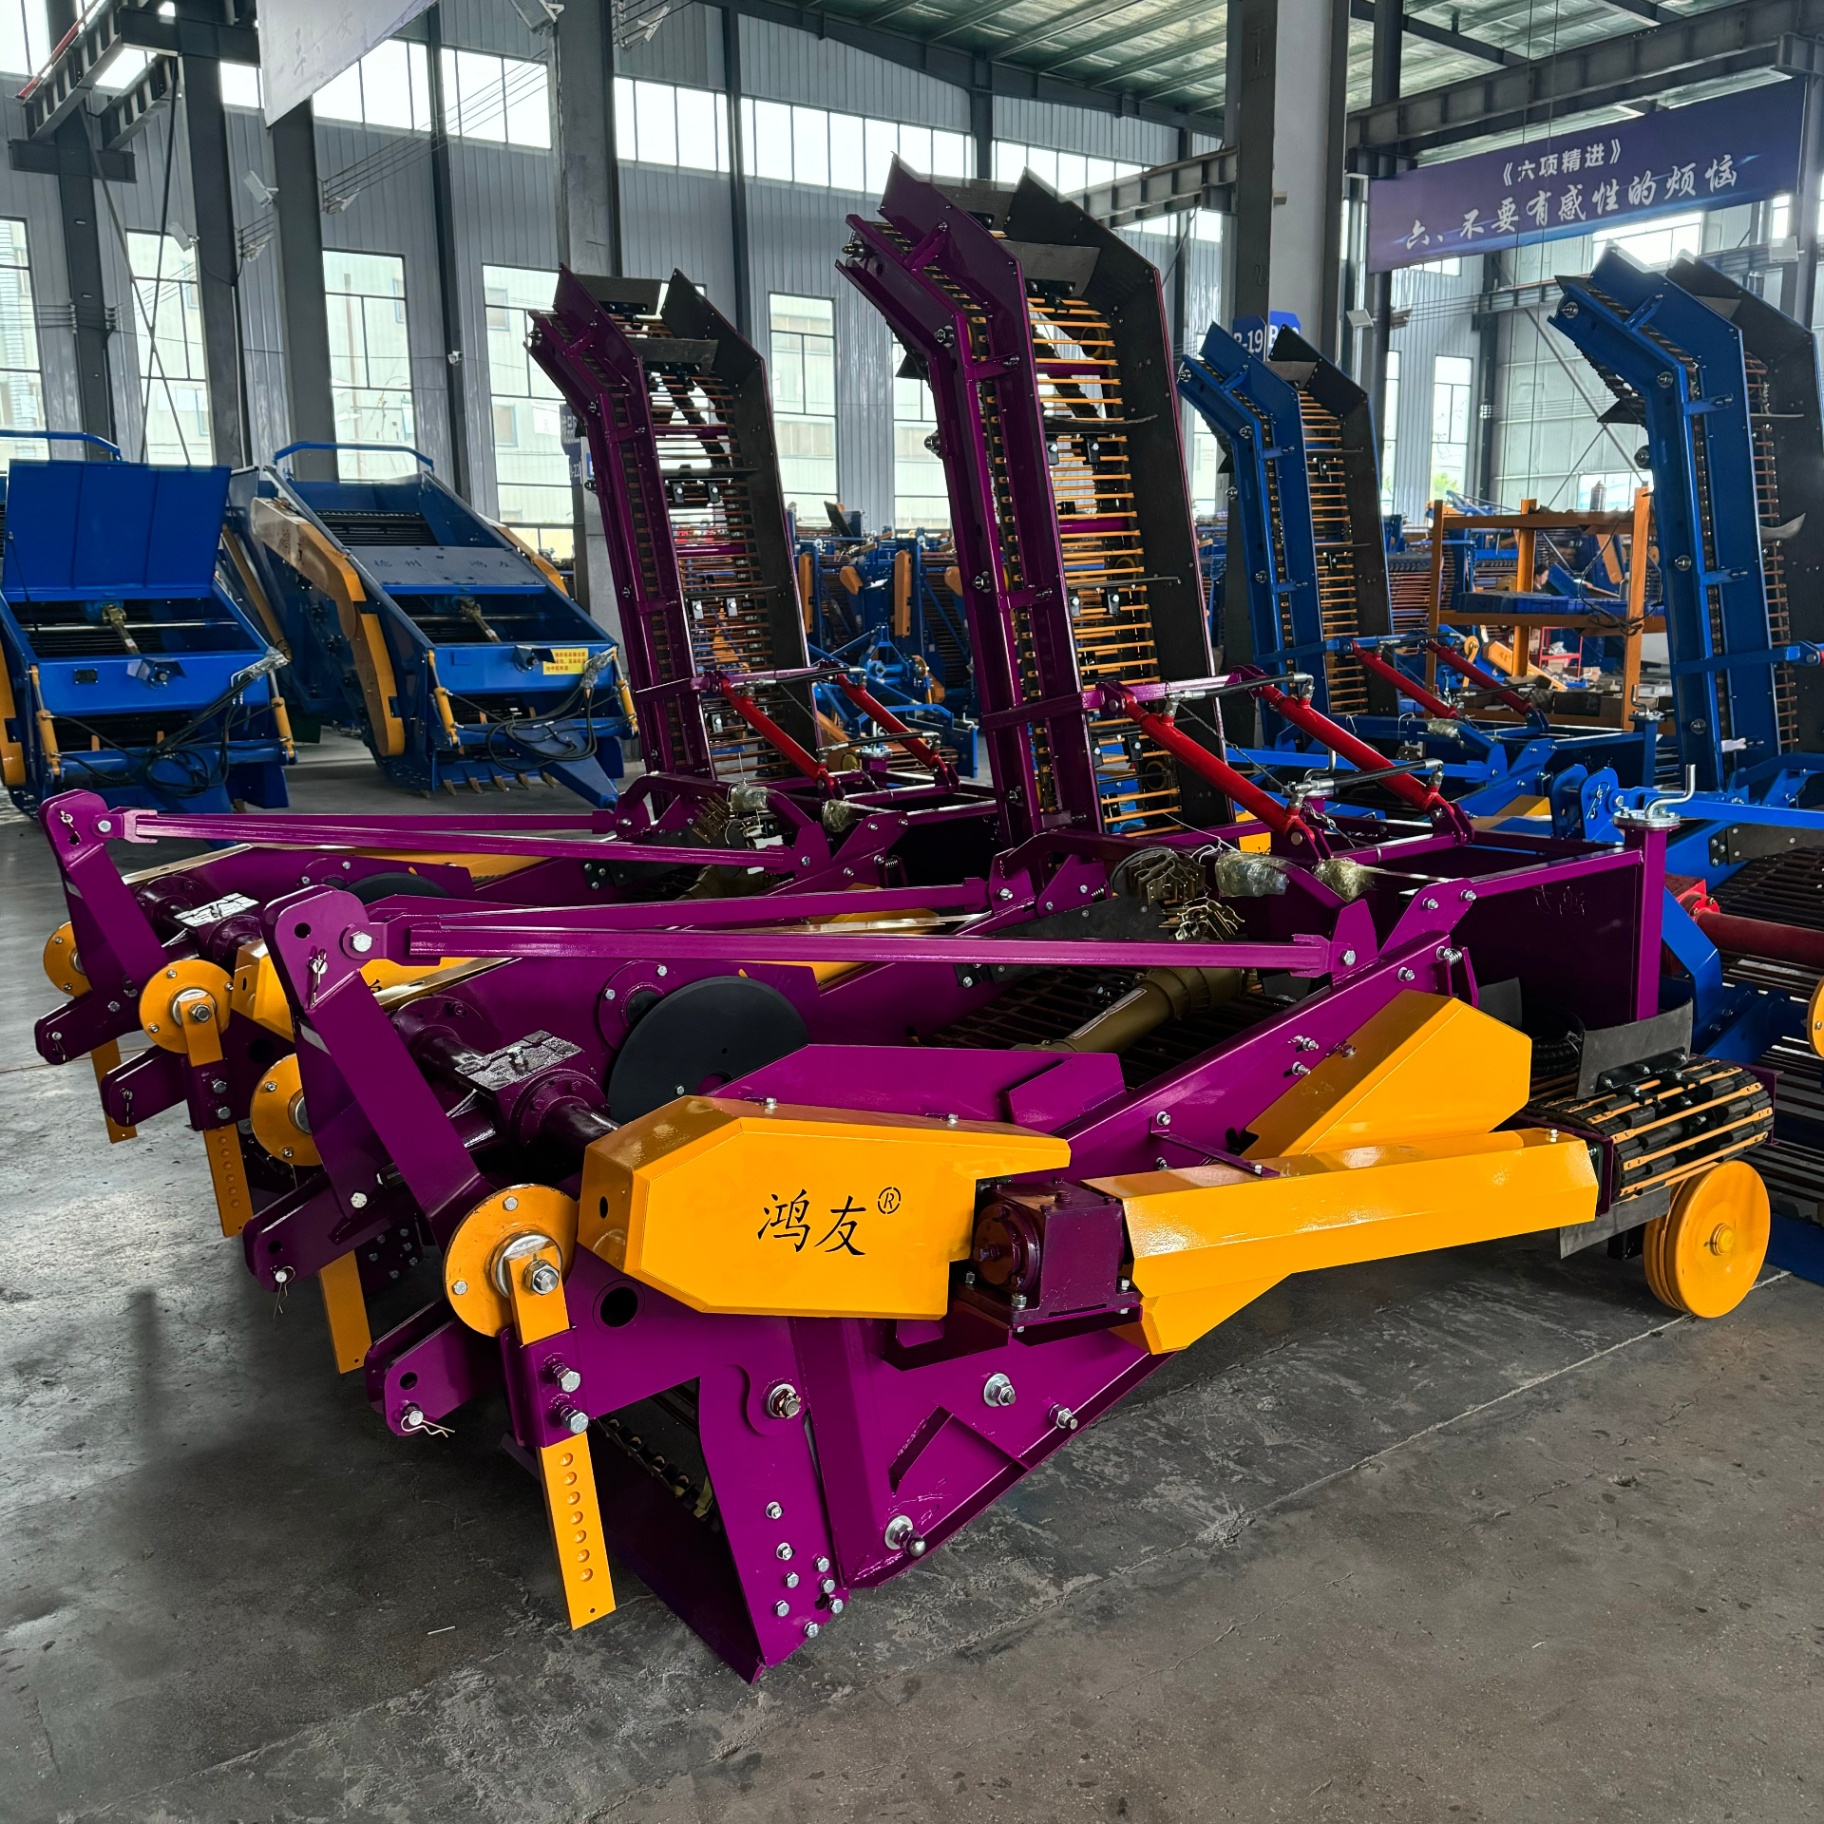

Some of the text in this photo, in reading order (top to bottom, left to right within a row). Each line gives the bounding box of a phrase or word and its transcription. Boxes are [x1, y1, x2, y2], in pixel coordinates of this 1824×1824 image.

[1503, 139, 1621, 186] 《六项精进》
[1406, 154, 1737, 249] 六、不要有感性的烦恼
